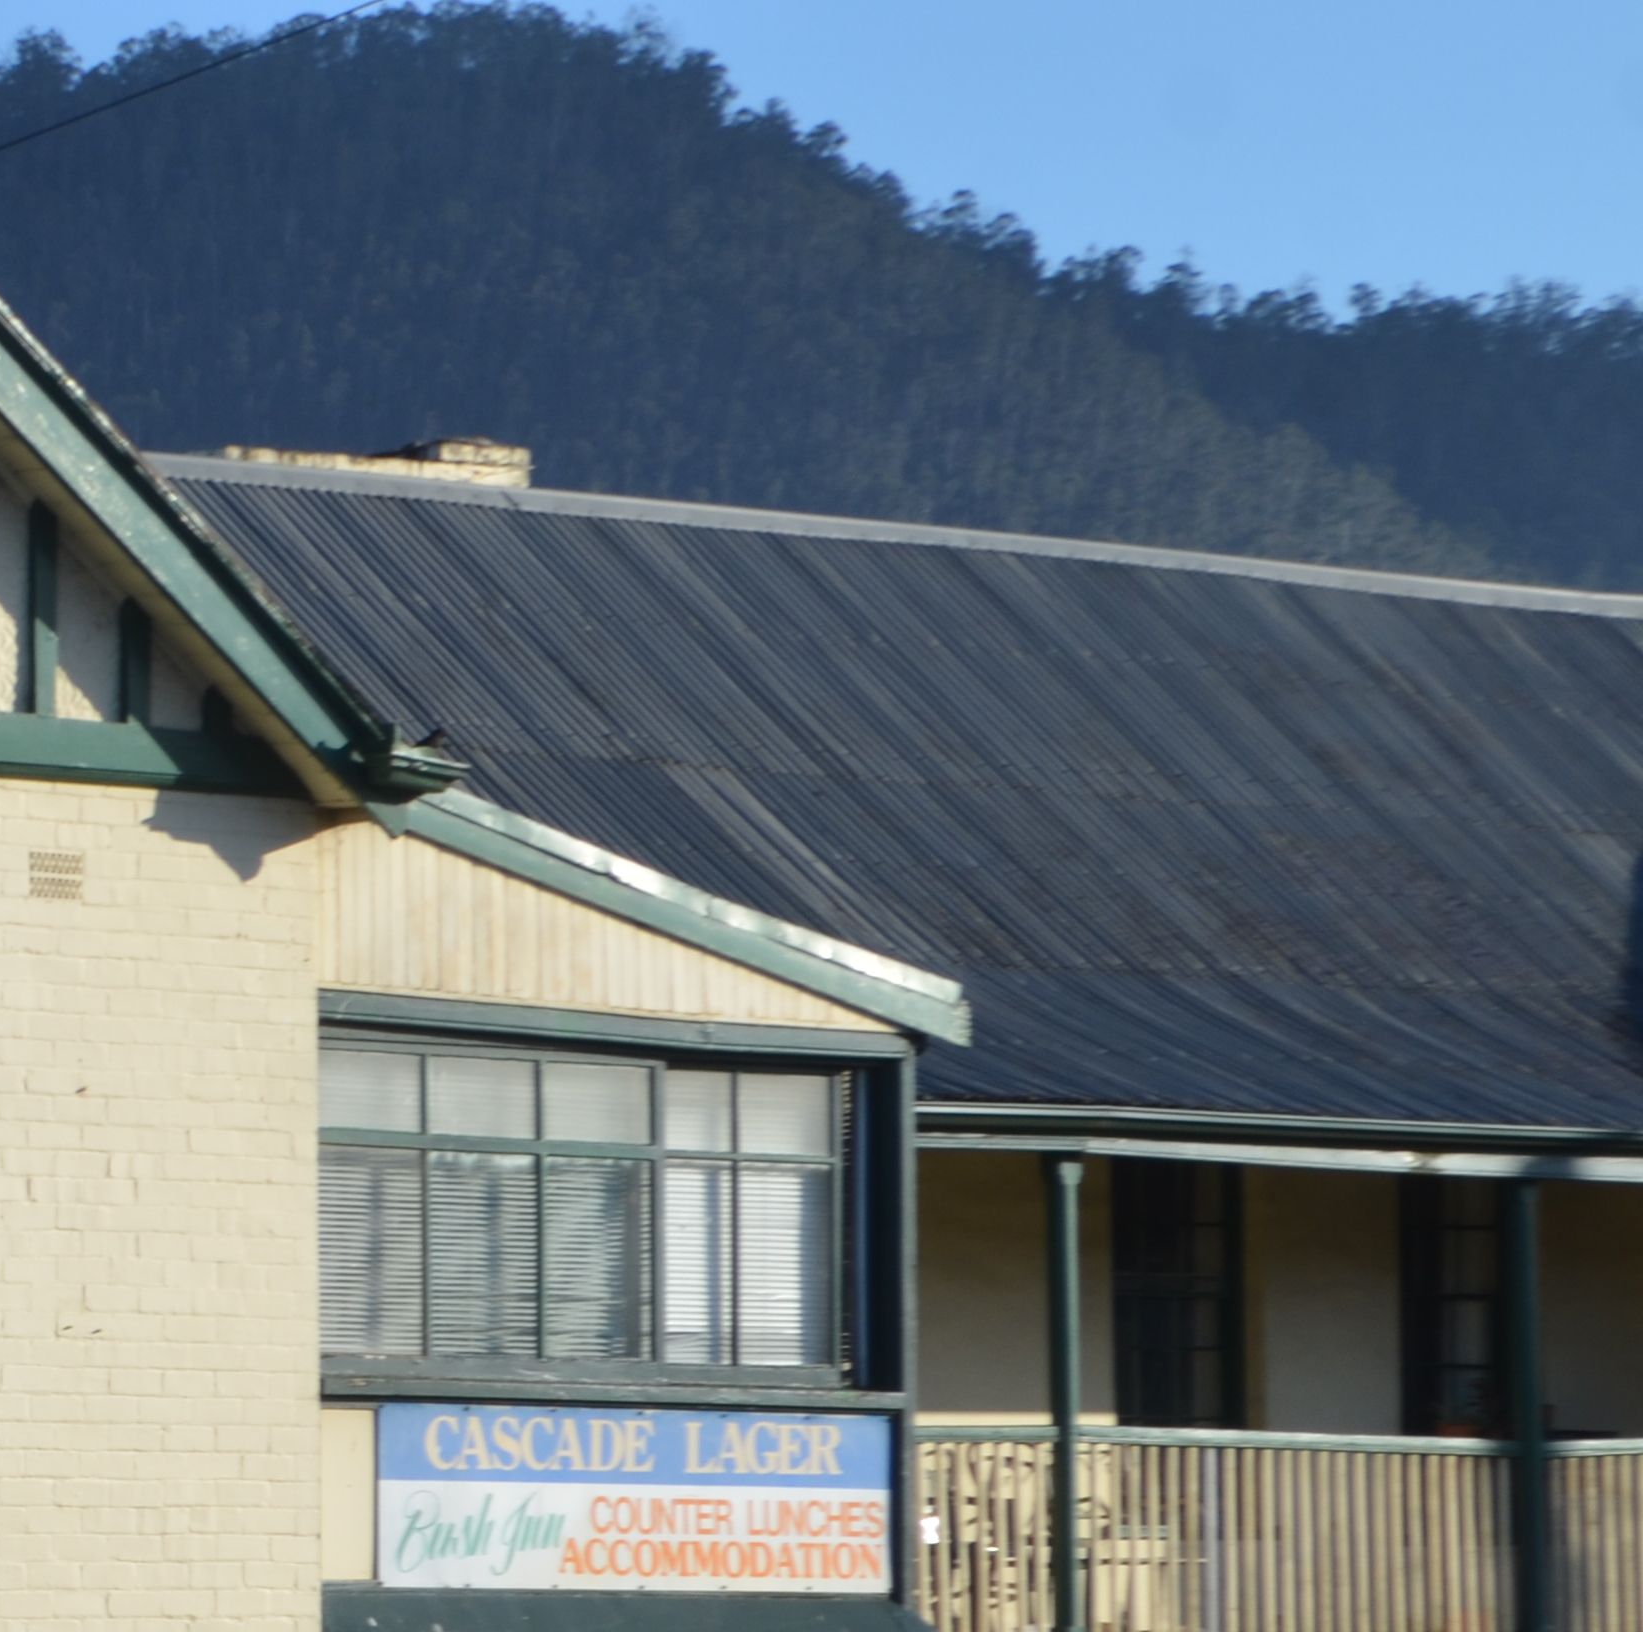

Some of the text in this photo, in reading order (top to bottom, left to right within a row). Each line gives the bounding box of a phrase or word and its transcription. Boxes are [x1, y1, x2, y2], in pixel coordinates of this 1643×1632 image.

[423, 1414, 843, 1475] CASCADE LAGER
[395, 1490, 566, 1576] Bush Inn
[590, 1495, 885, 1539] COUNTER LUNCHES
[559, 1537, 883, 1580] ACCOMMODATION
